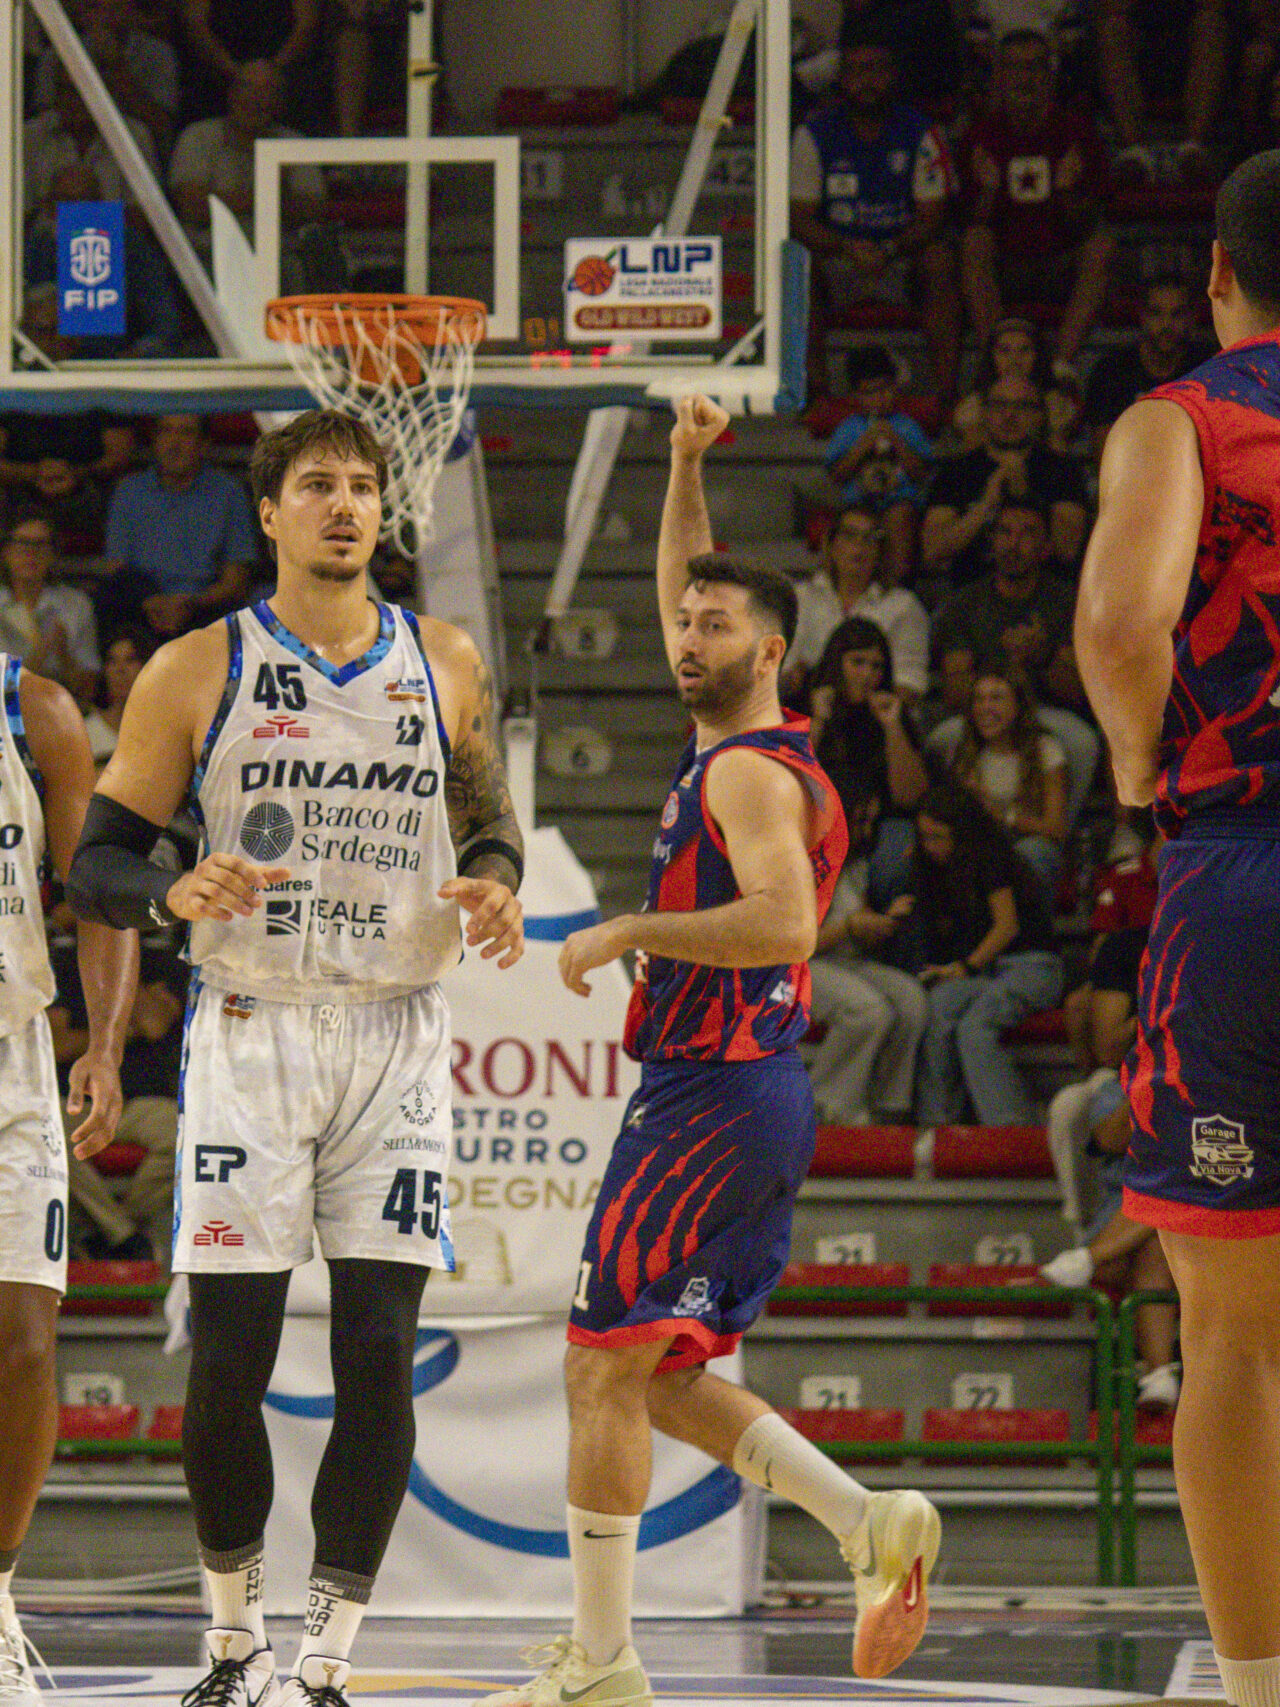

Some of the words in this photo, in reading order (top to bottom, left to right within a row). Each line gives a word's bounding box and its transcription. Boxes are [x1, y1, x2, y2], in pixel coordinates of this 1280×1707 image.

[621, 245, 713, 273] LNP
[64, 289, 119, 312] FIP
[253, 661, 308, 712] 45
[241, 759, 439, 798] DINAMO
[303, 800, 389, 831] Banco
[396, 808, 423, 837] di
[451, 1038, 620, 1098] RONI
[452, 1108, 549, 1130] STRO
[1200, 1124, 1236, 1139] Garage
[195, 1144, 248, 1183] EP
[455, 1137, 588, 1165] URRO
[1201, 1165, 1216, 1174] Via
[1218, 1165, 1242, 1175] Nova
[382, 1168, 443, 1240] 45
[448, 1176, 602, 1211] DEGN
[44, 1198, 65, 1262] 0
